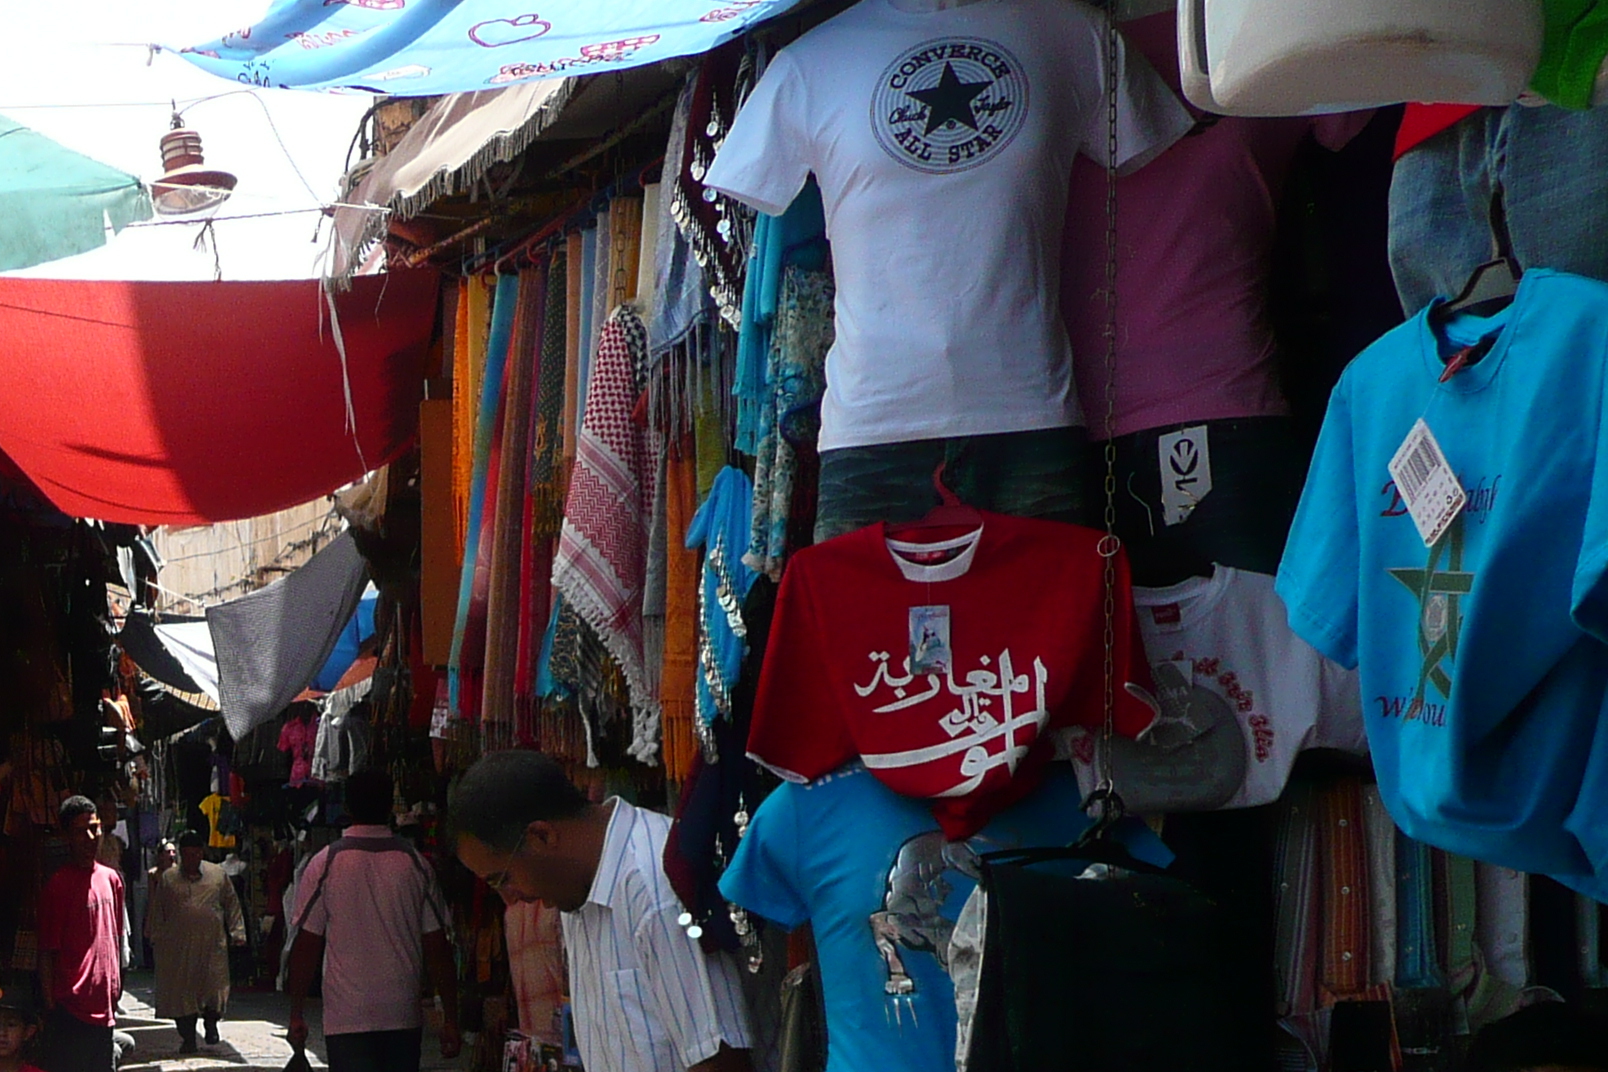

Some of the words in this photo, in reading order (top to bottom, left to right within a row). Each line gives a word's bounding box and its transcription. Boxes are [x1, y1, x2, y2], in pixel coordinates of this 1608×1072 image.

[890, 44, 1011, 89] CONVERCE
[894, 127, 933, 161] ALL
[948, 124, 1003, 164] STAR
